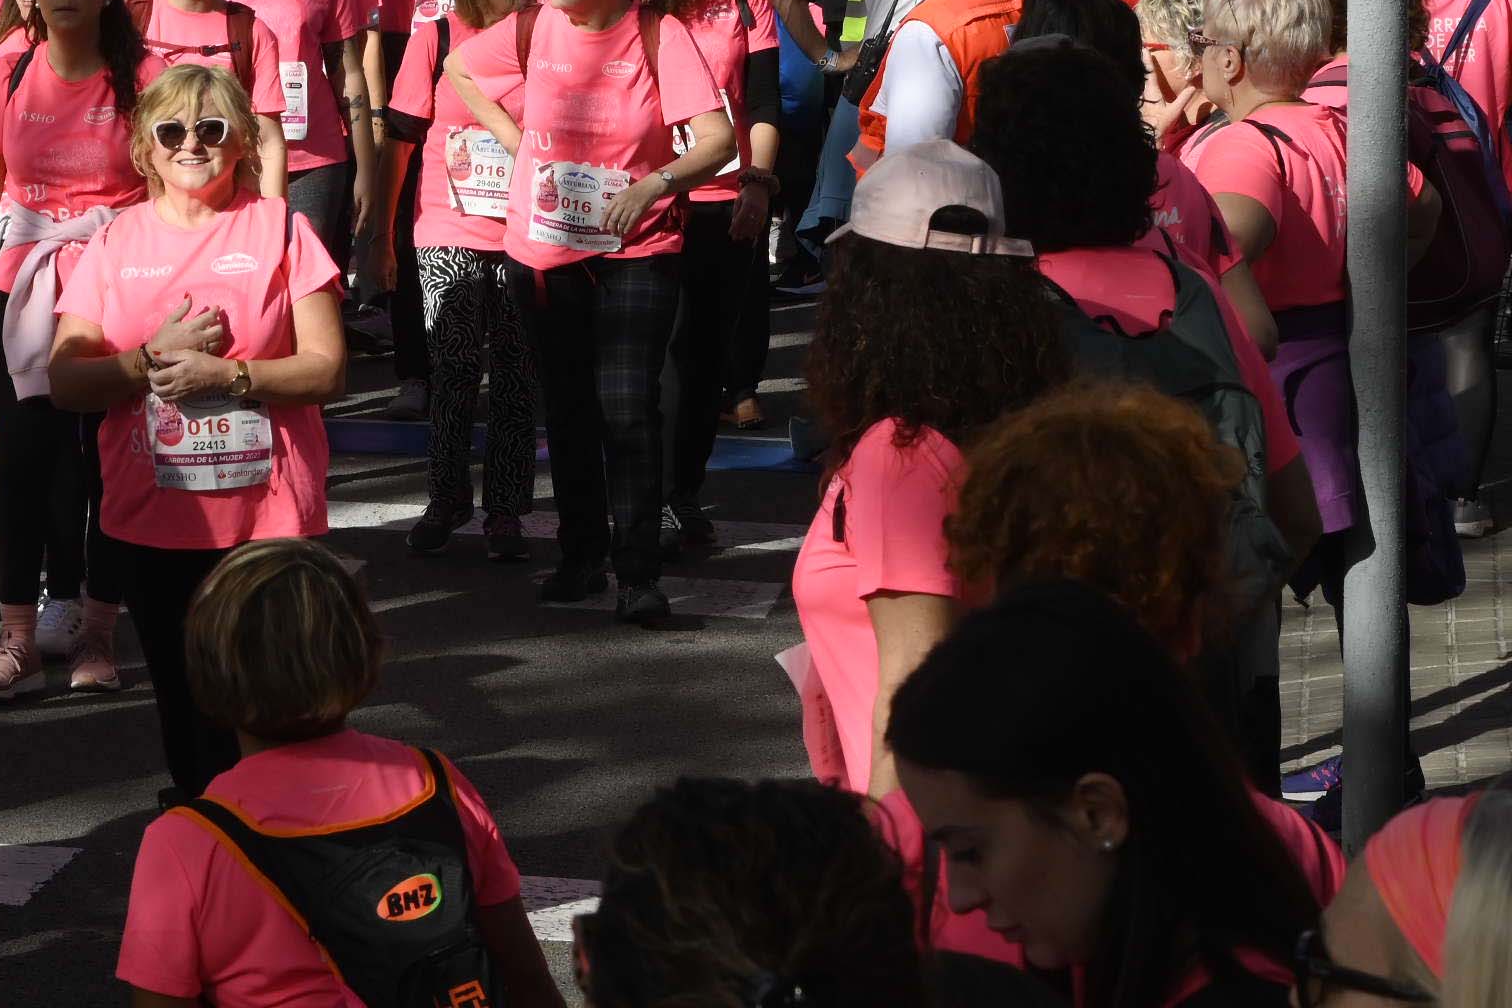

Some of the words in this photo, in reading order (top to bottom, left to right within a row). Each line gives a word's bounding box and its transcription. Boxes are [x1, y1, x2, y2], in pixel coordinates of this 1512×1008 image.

[528, 130, 552, 152] TU
[475, 164, 506, 178] 016
[457, 187, 478, 196] ARRERA
[561, 197, 592, 213] 016
[562, 212, 586, 225] 22411
[187, 417, 231, 436] 016
[192, 439, 227, 451] 22413
[208, 455, 218, 463] LA
[219, 454, 244, 463] MUJER
